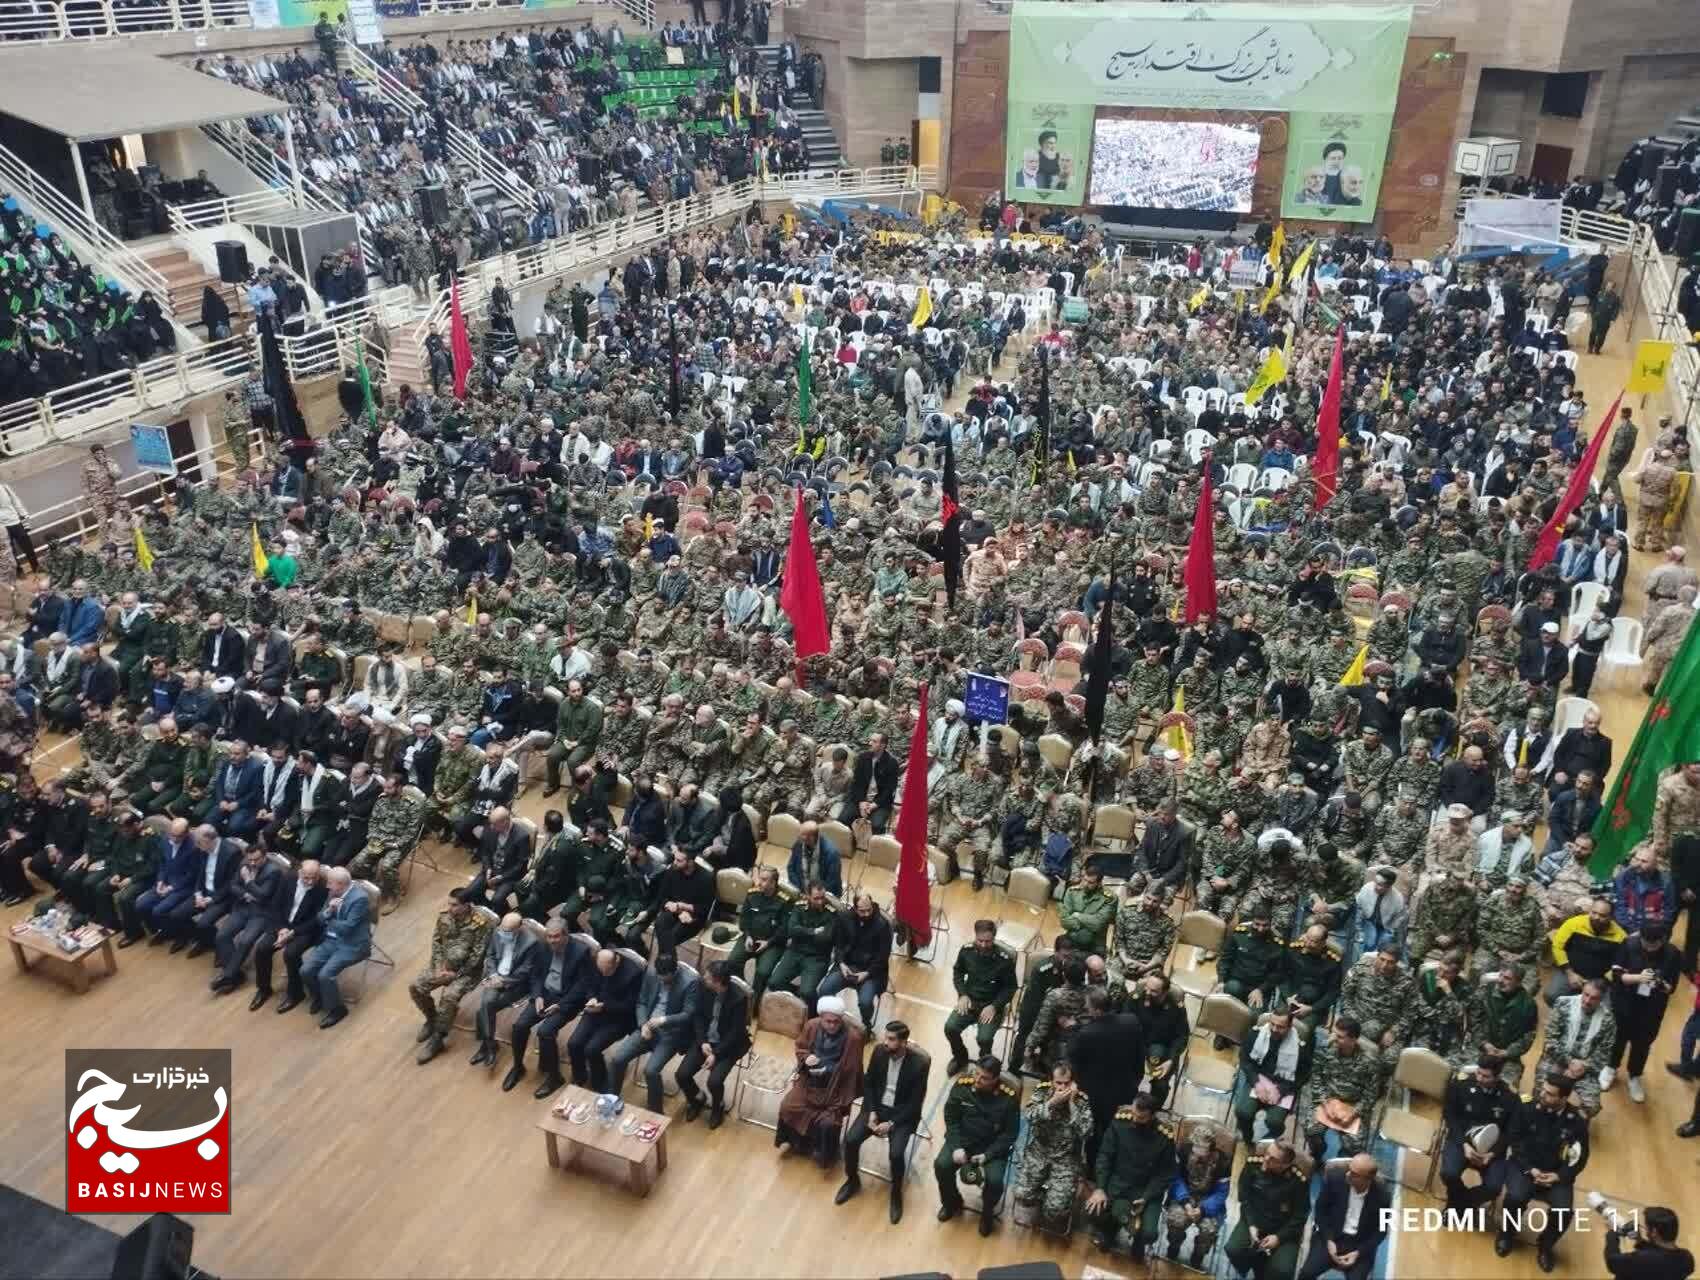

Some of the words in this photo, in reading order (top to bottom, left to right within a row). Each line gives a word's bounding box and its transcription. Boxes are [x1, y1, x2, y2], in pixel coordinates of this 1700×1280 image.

[1106, 40, 1157, 79] بسیج
[1141, 41, 1201, 71] اقتدار
[1215, 36, 1295, 82] رزمایش
